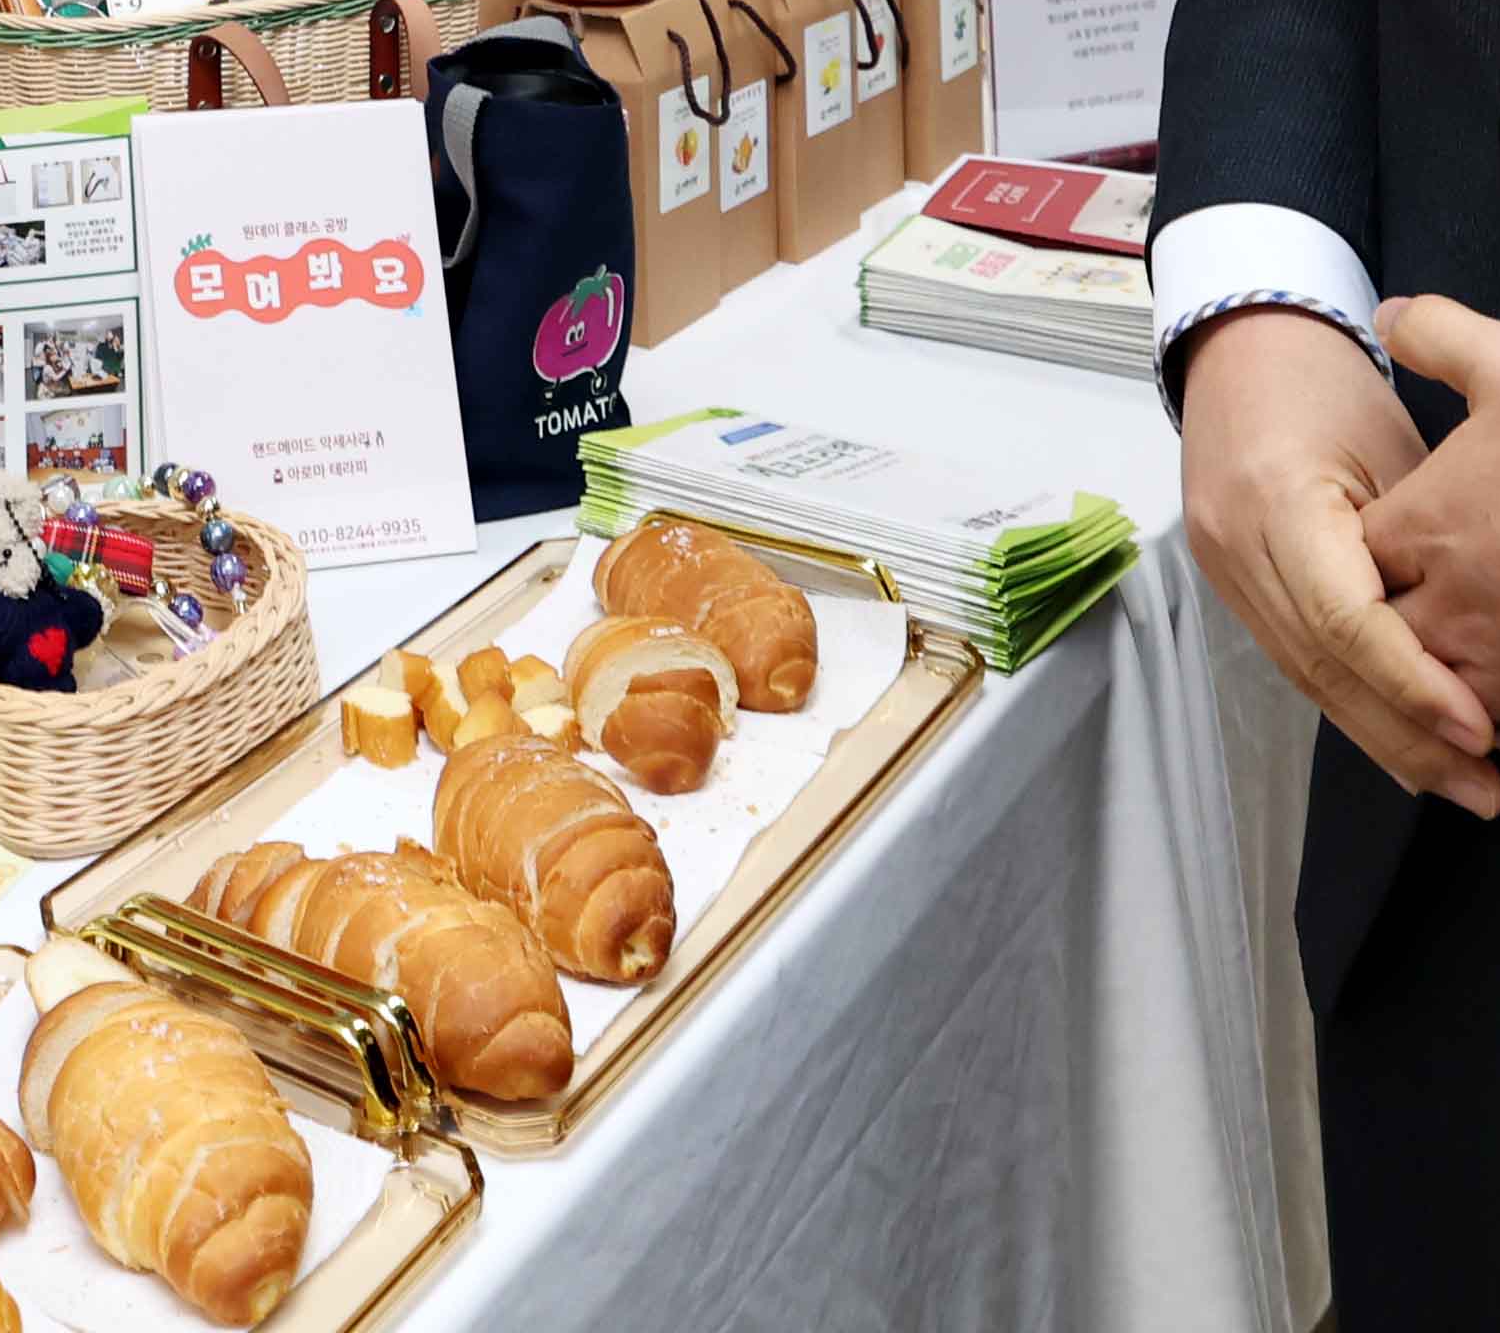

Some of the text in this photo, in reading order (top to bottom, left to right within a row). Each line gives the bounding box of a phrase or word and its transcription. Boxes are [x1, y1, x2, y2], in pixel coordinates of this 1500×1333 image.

[189, 250, 409, 310] 모여봐요
[287, 459, 368, 481] 아로마 테라피
[298, 518, 422, 547] 010-8244-9935
